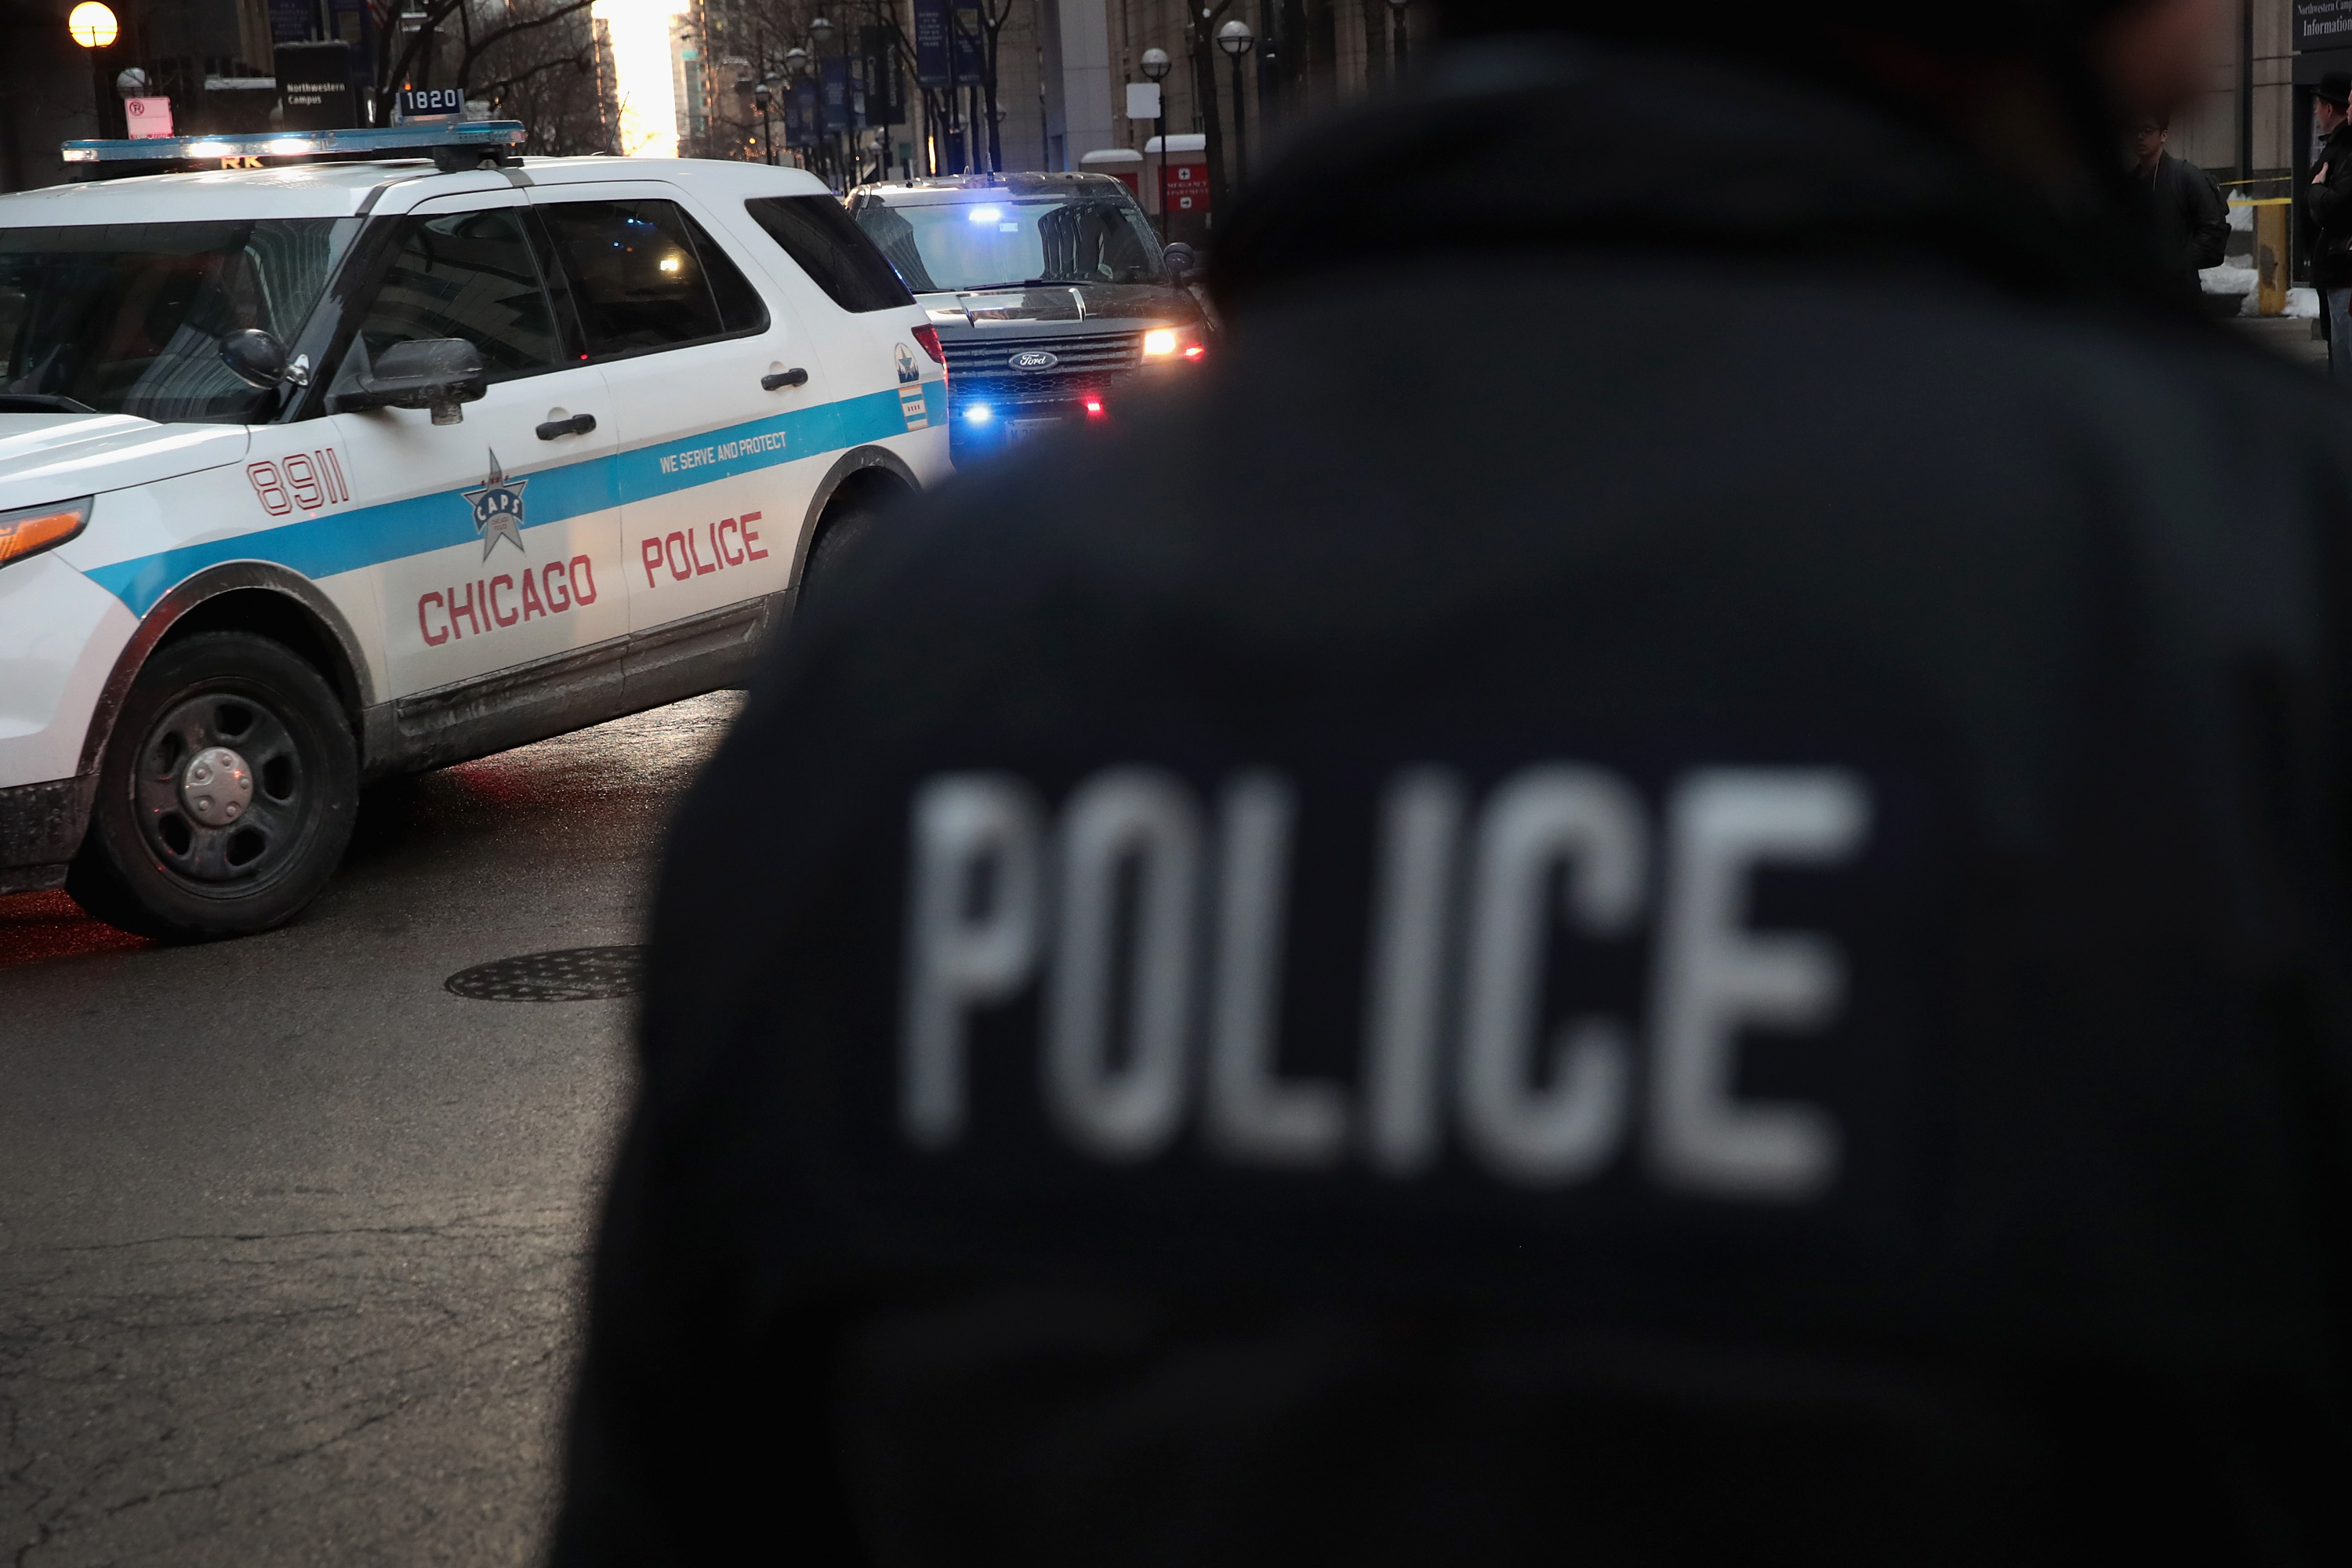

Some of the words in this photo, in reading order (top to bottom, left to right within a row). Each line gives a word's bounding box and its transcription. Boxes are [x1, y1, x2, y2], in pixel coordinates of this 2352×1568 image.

[2298, 3, 2335, 15] Northwestern
[2303, 15, 2352, 36] Information
[287, 82, 346, 93] Northwestern
[288, 94, 322, 106] Campus
[407, 89, 456, 110] 1820
[1019, 354, 1046, 366] Ford
[659, 455, 679, 474] WE
[679, 446, 716, 470] SERVE
[717, 441, 739, 462] AND
[739, 431, 786, 456] PROTECT
[246, 448, 350, 517] 8911
[477, 494, 520, 521] CAPS
[418, 554, 597, 646] CHICAGO
[641, 511, 769, 588] POLICE
[898, 766, 1870, 1196] POLICE
